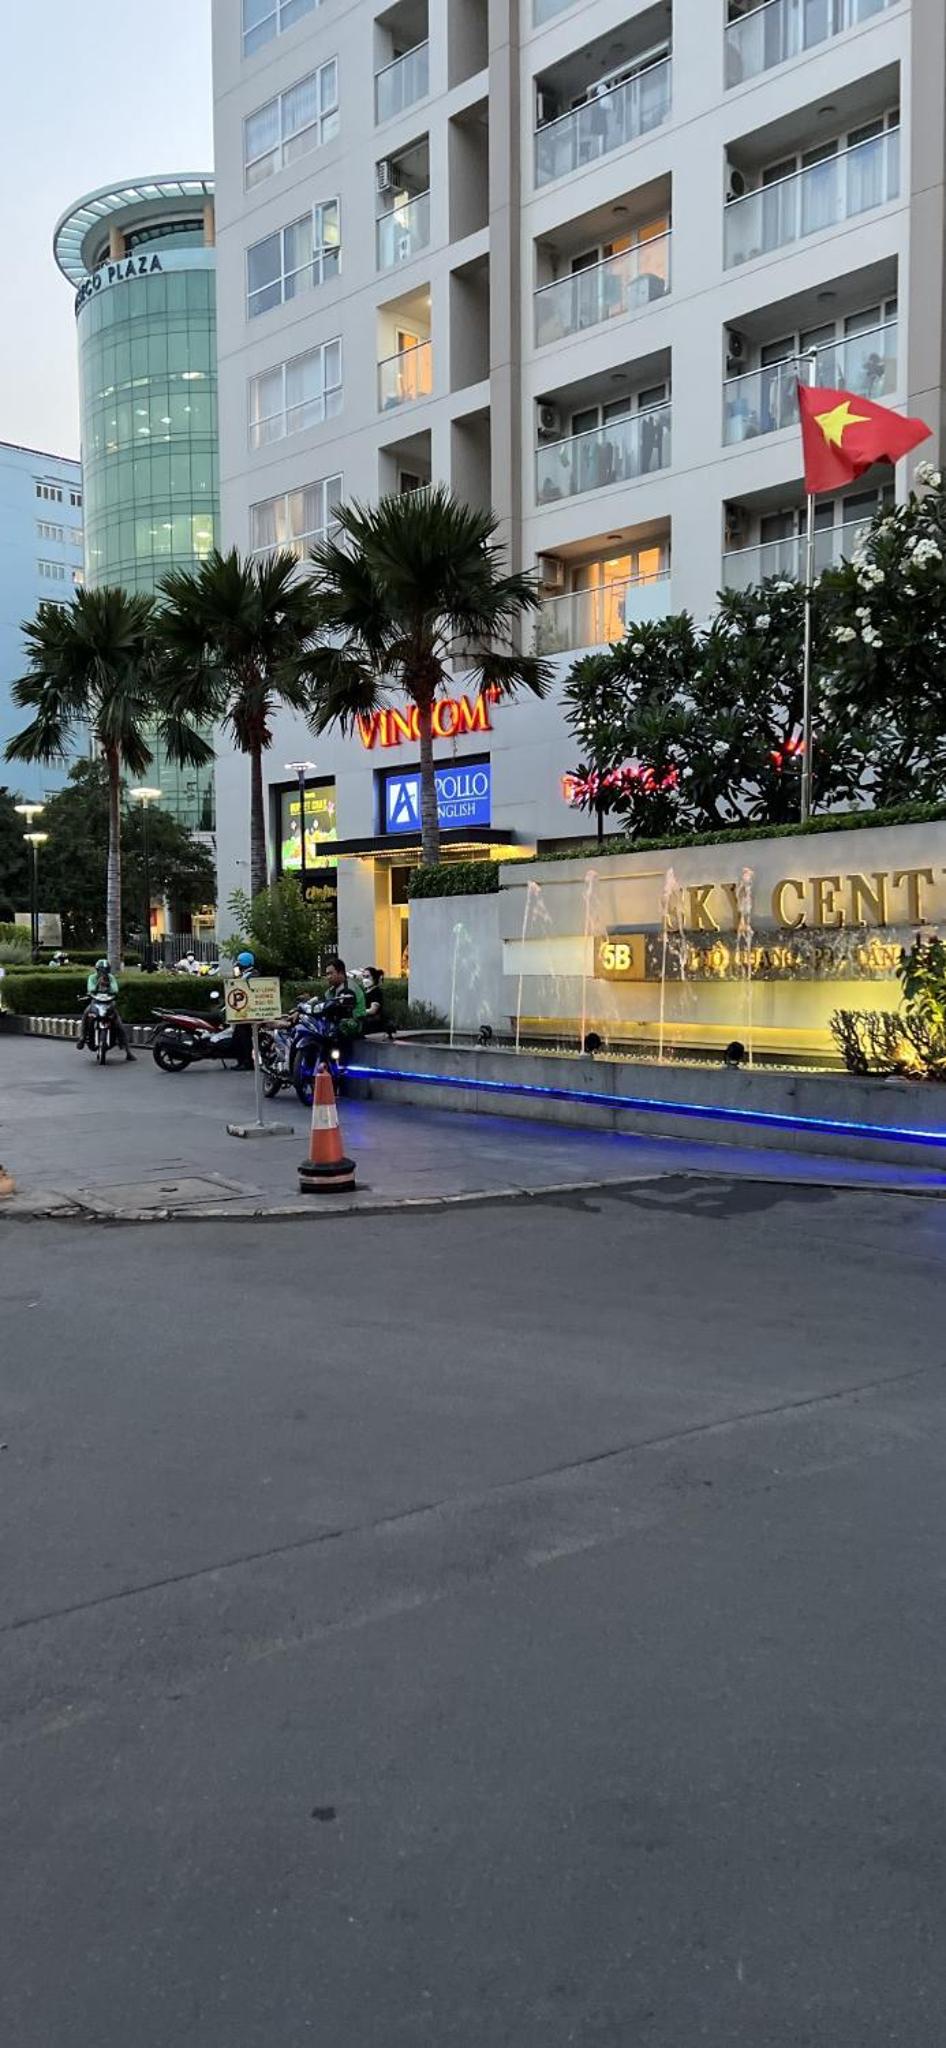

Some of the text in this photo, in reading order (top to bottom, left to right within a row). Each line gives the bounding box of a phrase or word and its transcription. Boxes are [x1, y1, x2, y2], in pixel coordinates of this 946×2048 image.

[107, 254, 163, 283] PLAZA
[434, 772, 488, 799] POLLO
[437, 802, 476, 819] NGLISH
[771, 867, 946, 929] CENT
[601, 944, 631, 971] 5B
